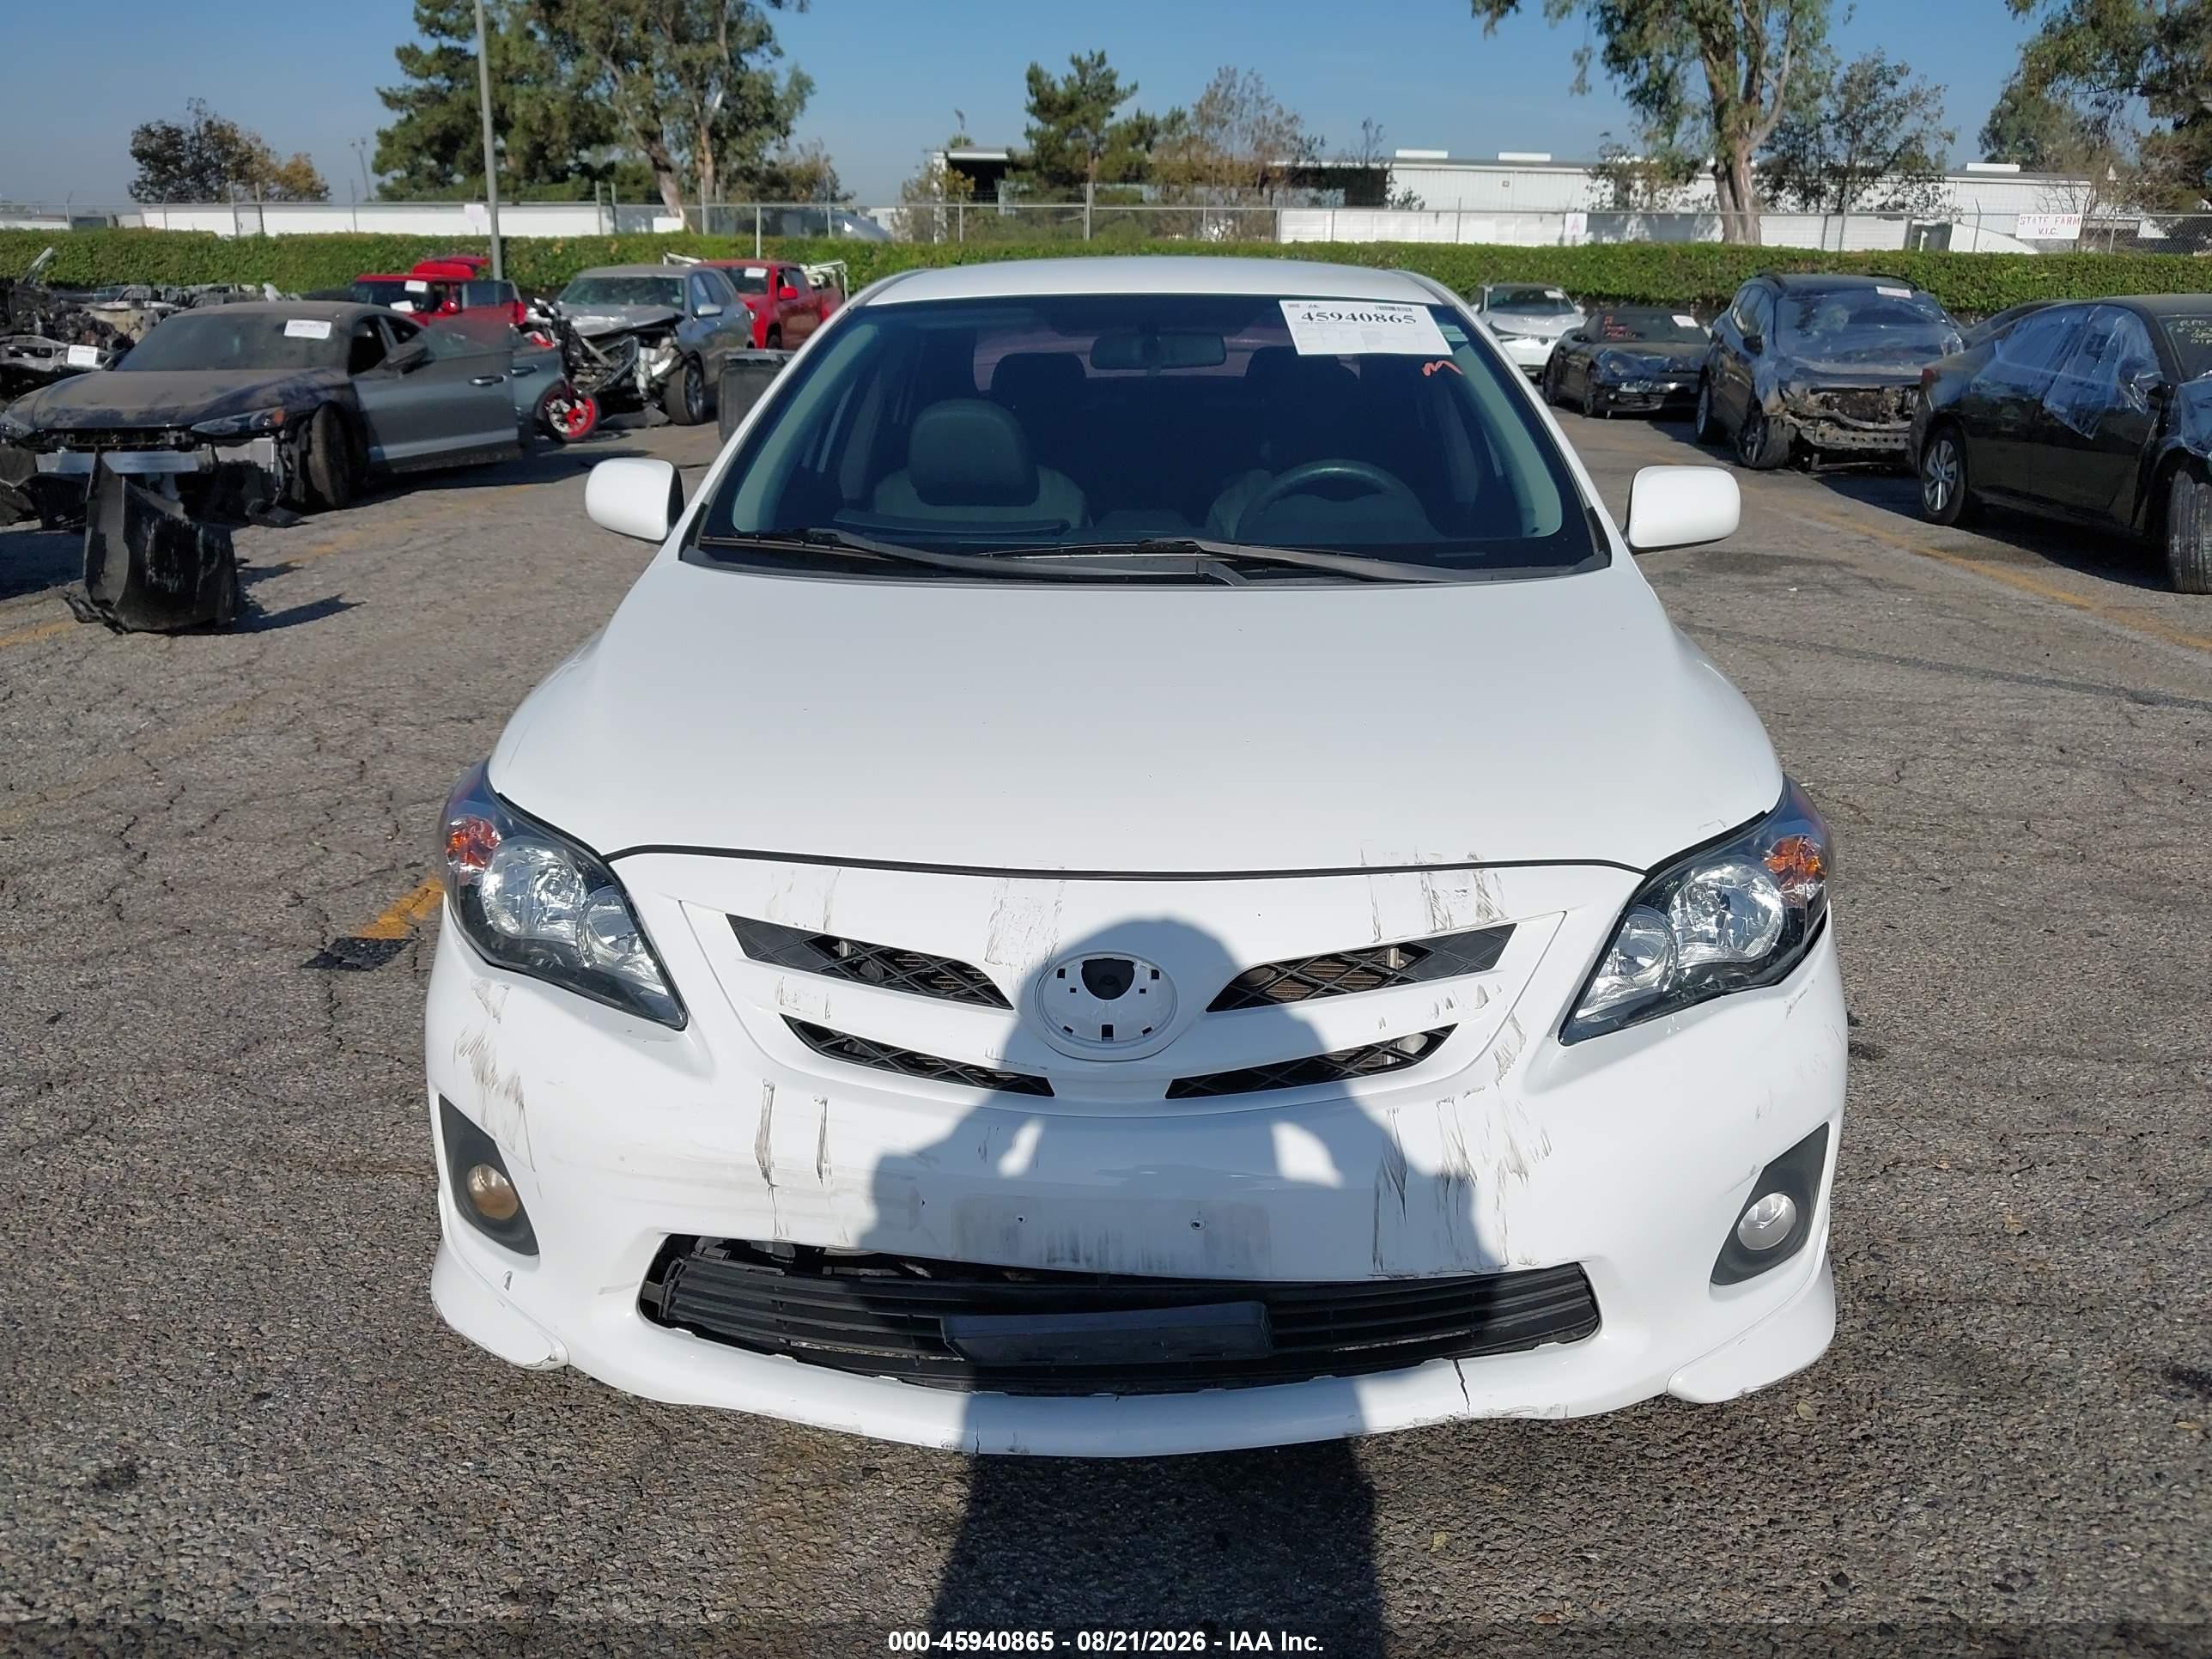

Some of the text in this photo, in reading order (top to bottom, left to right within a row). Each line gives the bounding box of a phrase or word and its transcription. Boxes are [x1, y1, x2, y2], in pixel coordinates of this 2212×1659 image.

[2020, 216, 2081, 226] STATE FARM
[1301, 311, 1417, 325] 45940865
